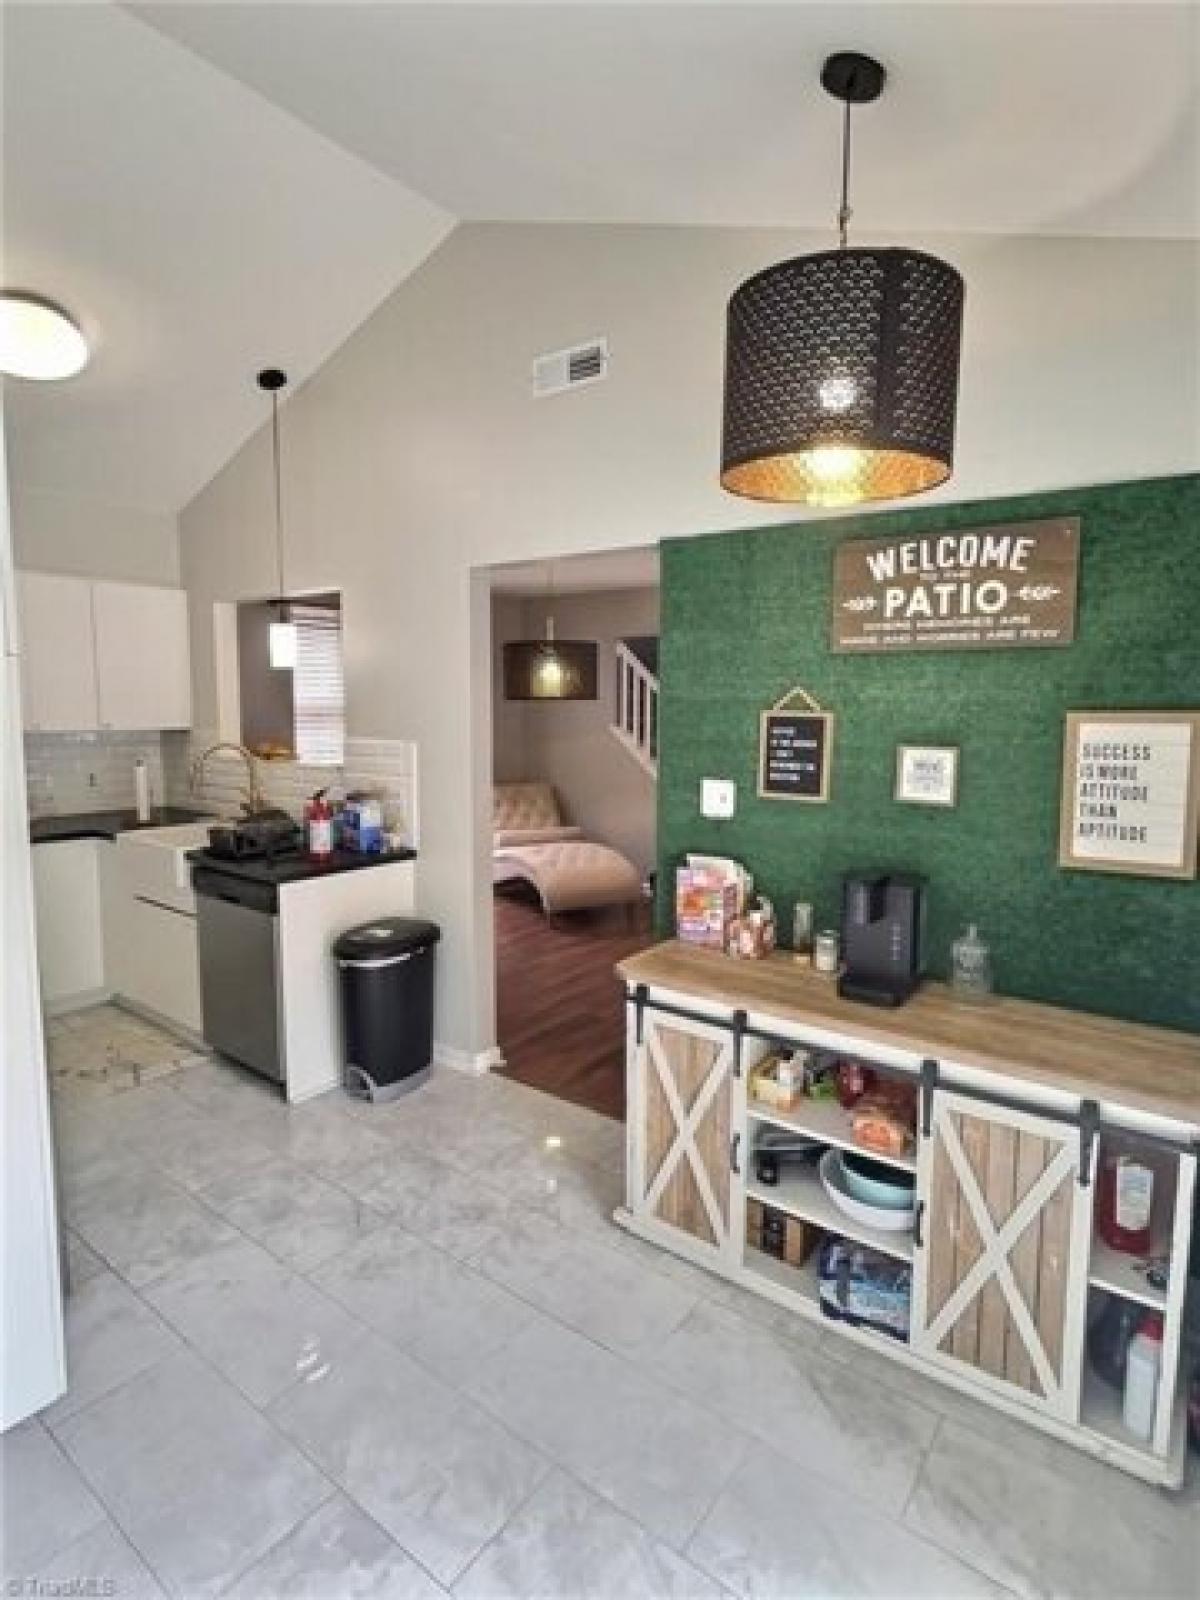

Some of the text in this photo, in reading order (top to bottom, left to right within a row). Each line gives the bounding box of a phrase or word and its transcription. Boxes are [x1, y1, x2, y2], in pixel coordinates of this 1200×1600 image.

[866, 534, 1037, 581] WELCOME
[883, 580, 1008, 617] PATIO
[1082, 742, 1151, 761] SUCCESS
[1080, 763, 1094, 780] IS
[1079, 782, 1148, 803] ATTITUDE
[1079, 803, 1118, 820] THAN
[1079, 823, 1148, 843] APTITUDE
